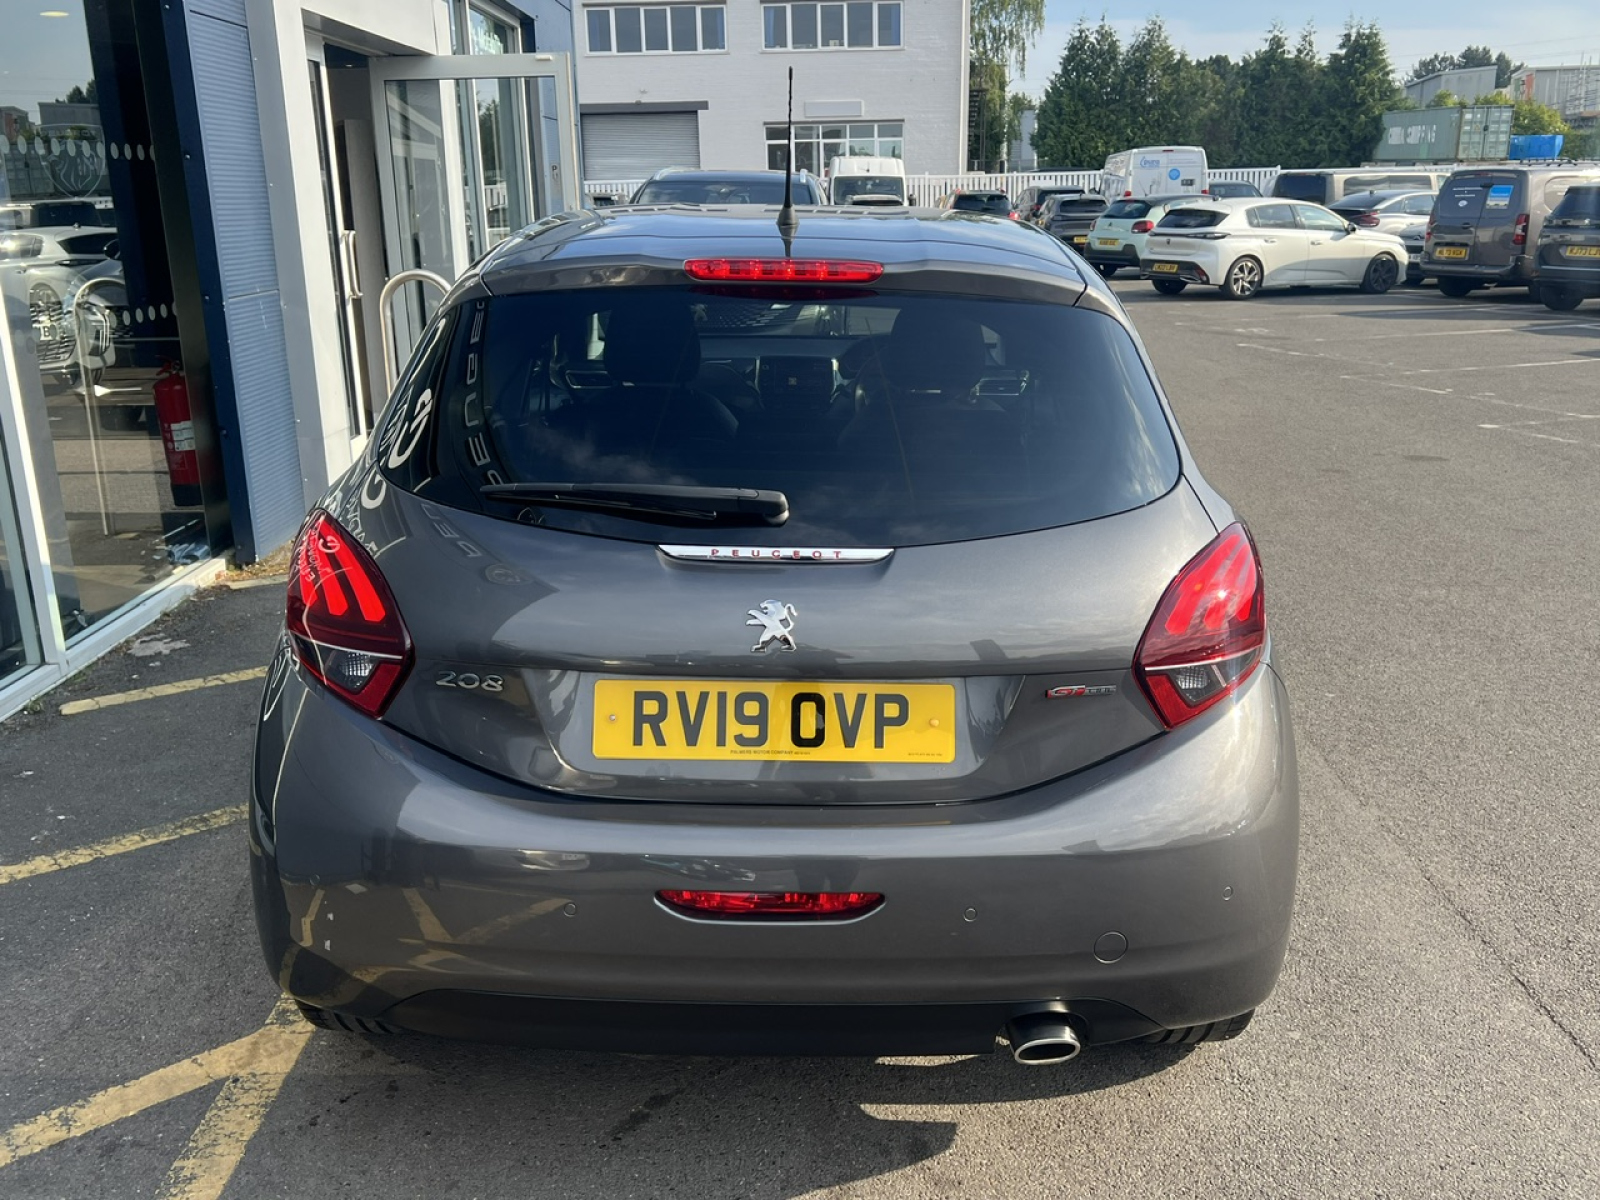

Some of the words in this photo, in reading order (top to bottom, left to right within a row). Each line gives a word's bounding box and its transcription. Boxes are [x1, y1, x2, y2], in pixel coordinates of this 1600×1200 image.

[710, 548, 842, 559] PEUGEOT
[436, 670, 503, 692] 208
[633, 691, 769, 747] RV19
[790, 691, 909, 749] OVP
